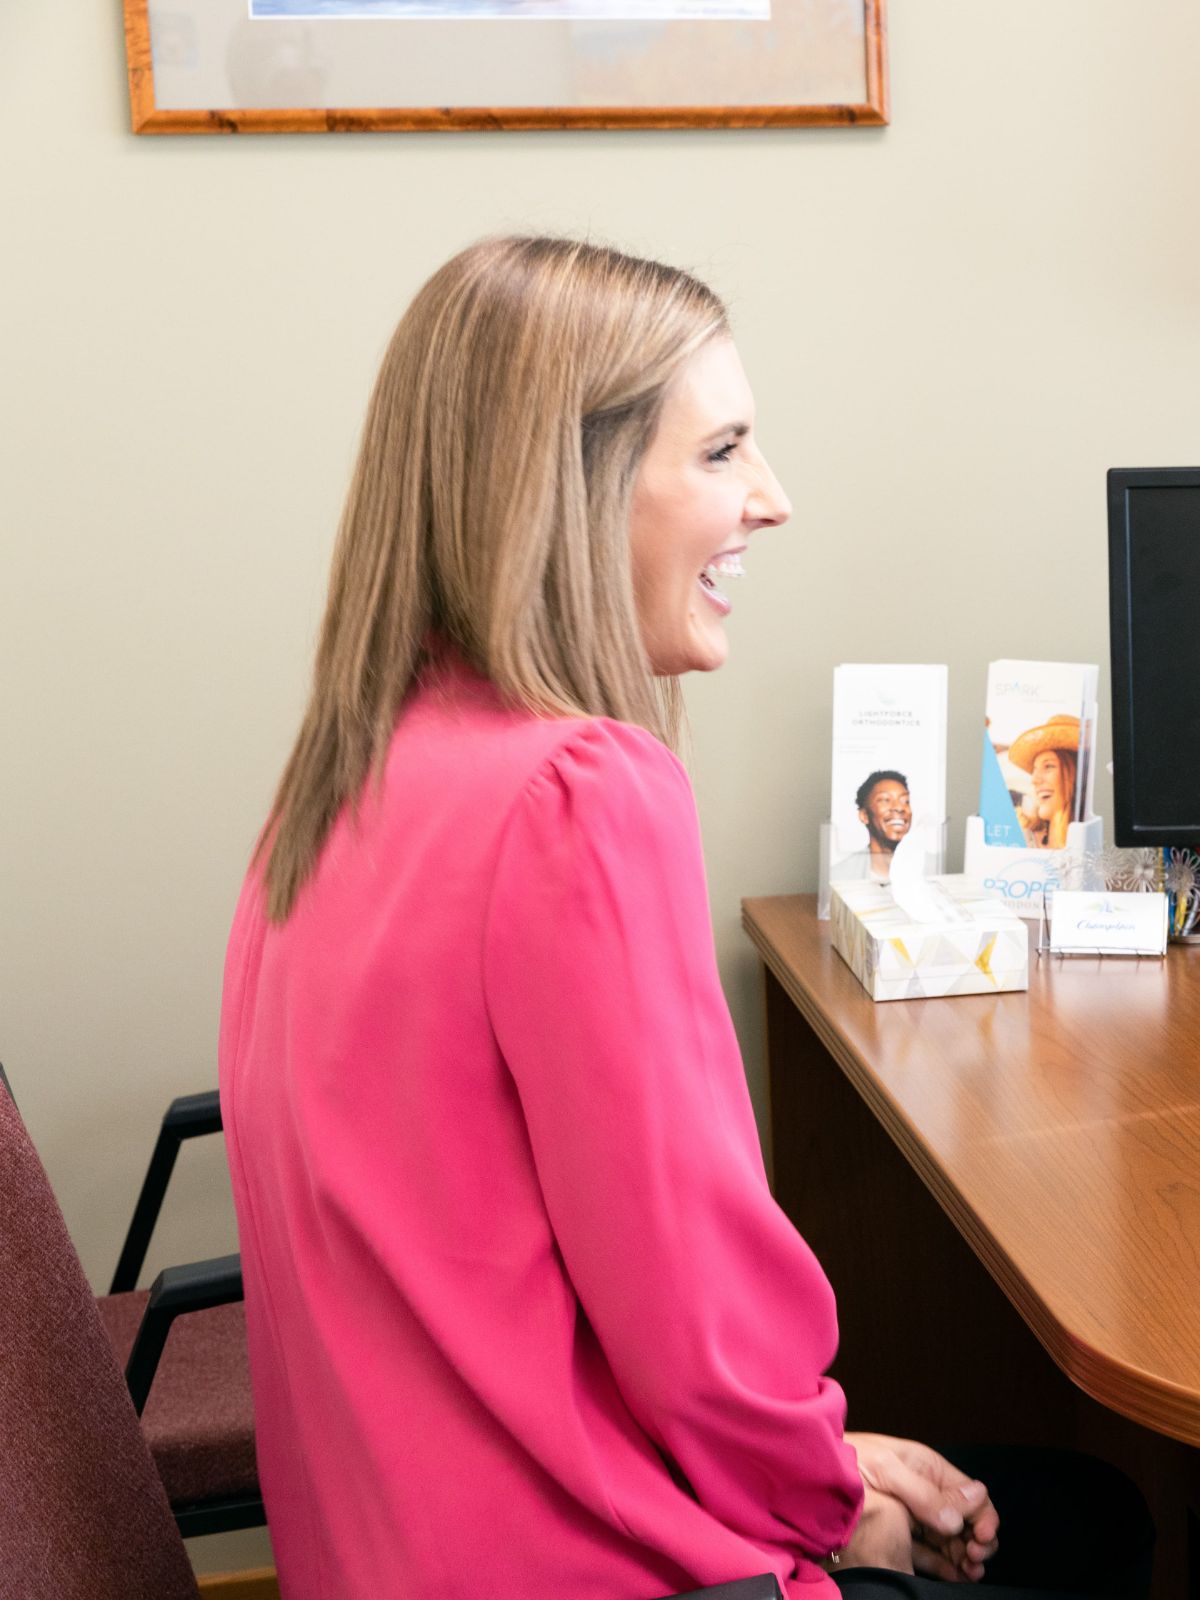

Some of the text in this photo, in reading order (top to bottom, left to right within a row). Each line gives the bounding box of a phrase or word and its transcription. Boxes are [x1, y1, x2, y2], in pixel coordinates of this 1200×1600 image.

[995, 681, 1040, 696] SPARK
[858, 710, 912, 718] LIGHTFORCE
[851, 719, 920, 727] ORTHODONTICS
[987, 825, 1011, 837] LET
[983, 878, 1060, 899] PROPE
